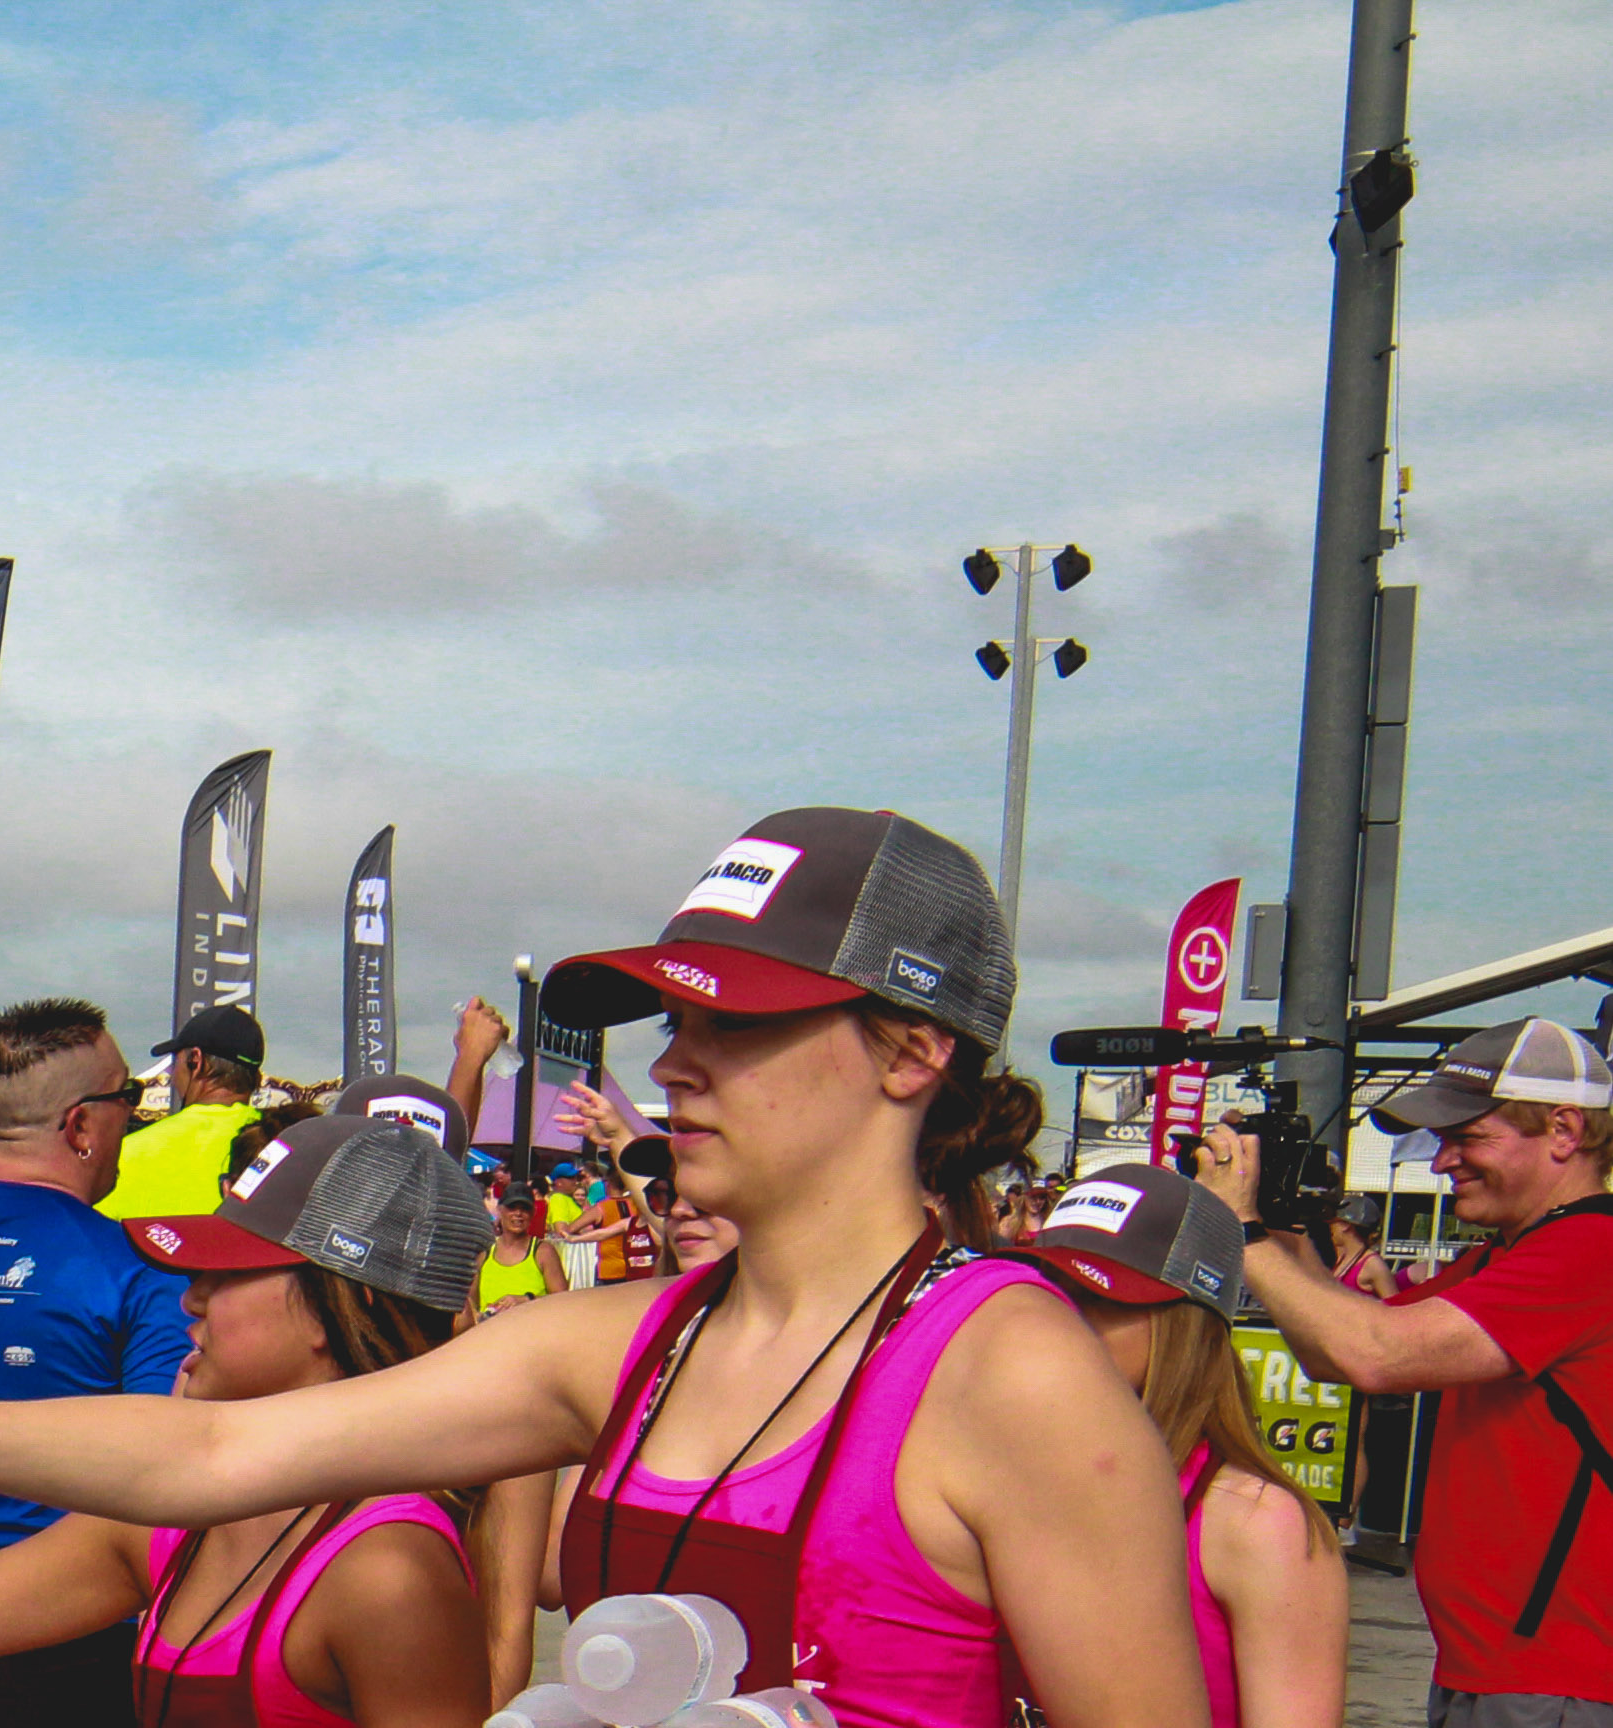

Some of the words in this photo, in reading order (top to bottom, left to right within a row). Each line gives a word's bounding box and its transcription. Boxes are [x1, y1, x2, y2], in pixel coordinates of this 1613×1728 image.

[722, 861, 773, 885] RACED
[214, 912, 251, 1014] LIN
[366, 956, 386, 1075] THERAP
[1096, 1037, 1154, 1054] RØDE
[1105, 1125, 1152, 1142] COX
